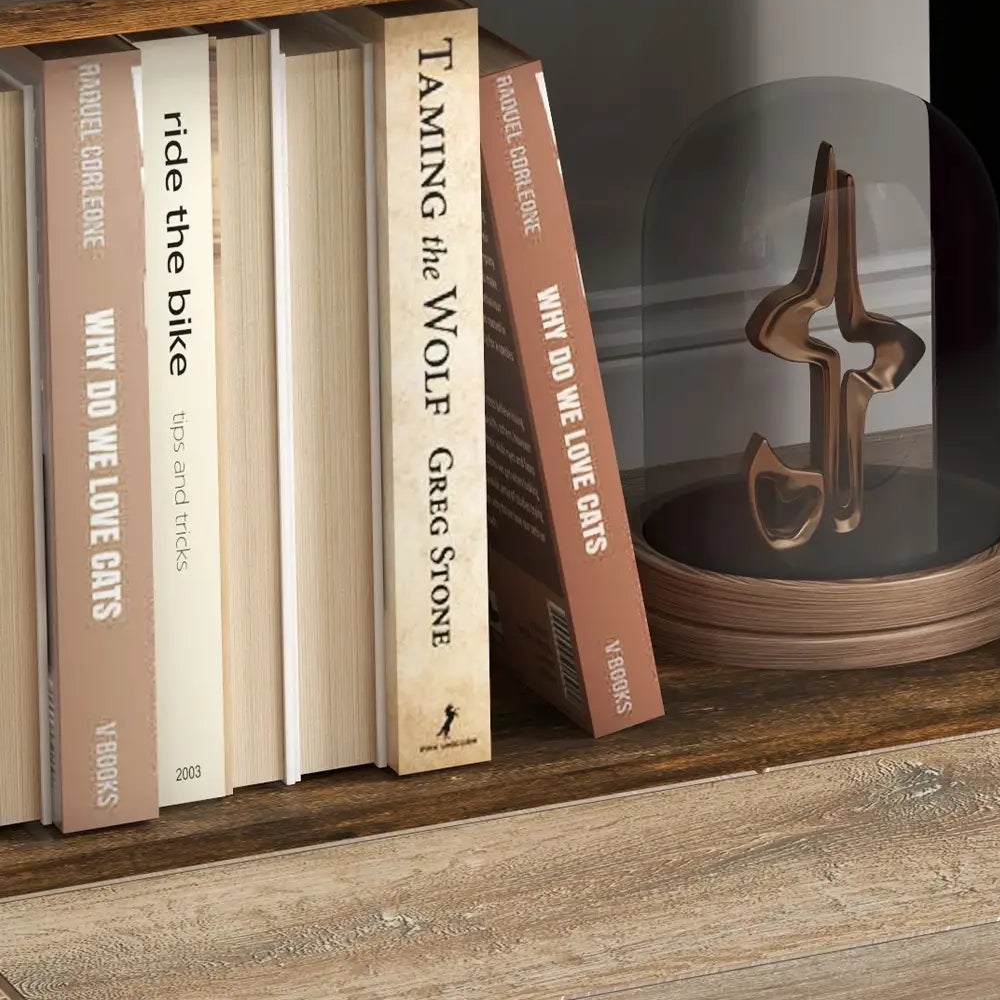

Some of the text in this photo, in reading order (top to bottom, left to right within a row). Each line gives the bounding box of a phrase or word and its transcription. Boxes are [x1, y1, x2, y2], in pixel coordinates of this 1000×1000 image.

[79, 64, 106, 248] RAQUEL CORLEONE
[163, 112, 192, 377] ride the bike
[418, 36, 458, 415] TAMING the WOLF
[496, 74, 542, 236] RAQUEL CORLEONE
[85, 307, 122, 620] WHY DO WE LOVE CATS
[169, 412, 191, 572] tips and tricks
[536, 284, 608, 555] WHY DO WE LOVE CATS
[428, 447, 456, 648] GREG STONE
[175, 764, 202, 782] 2003
